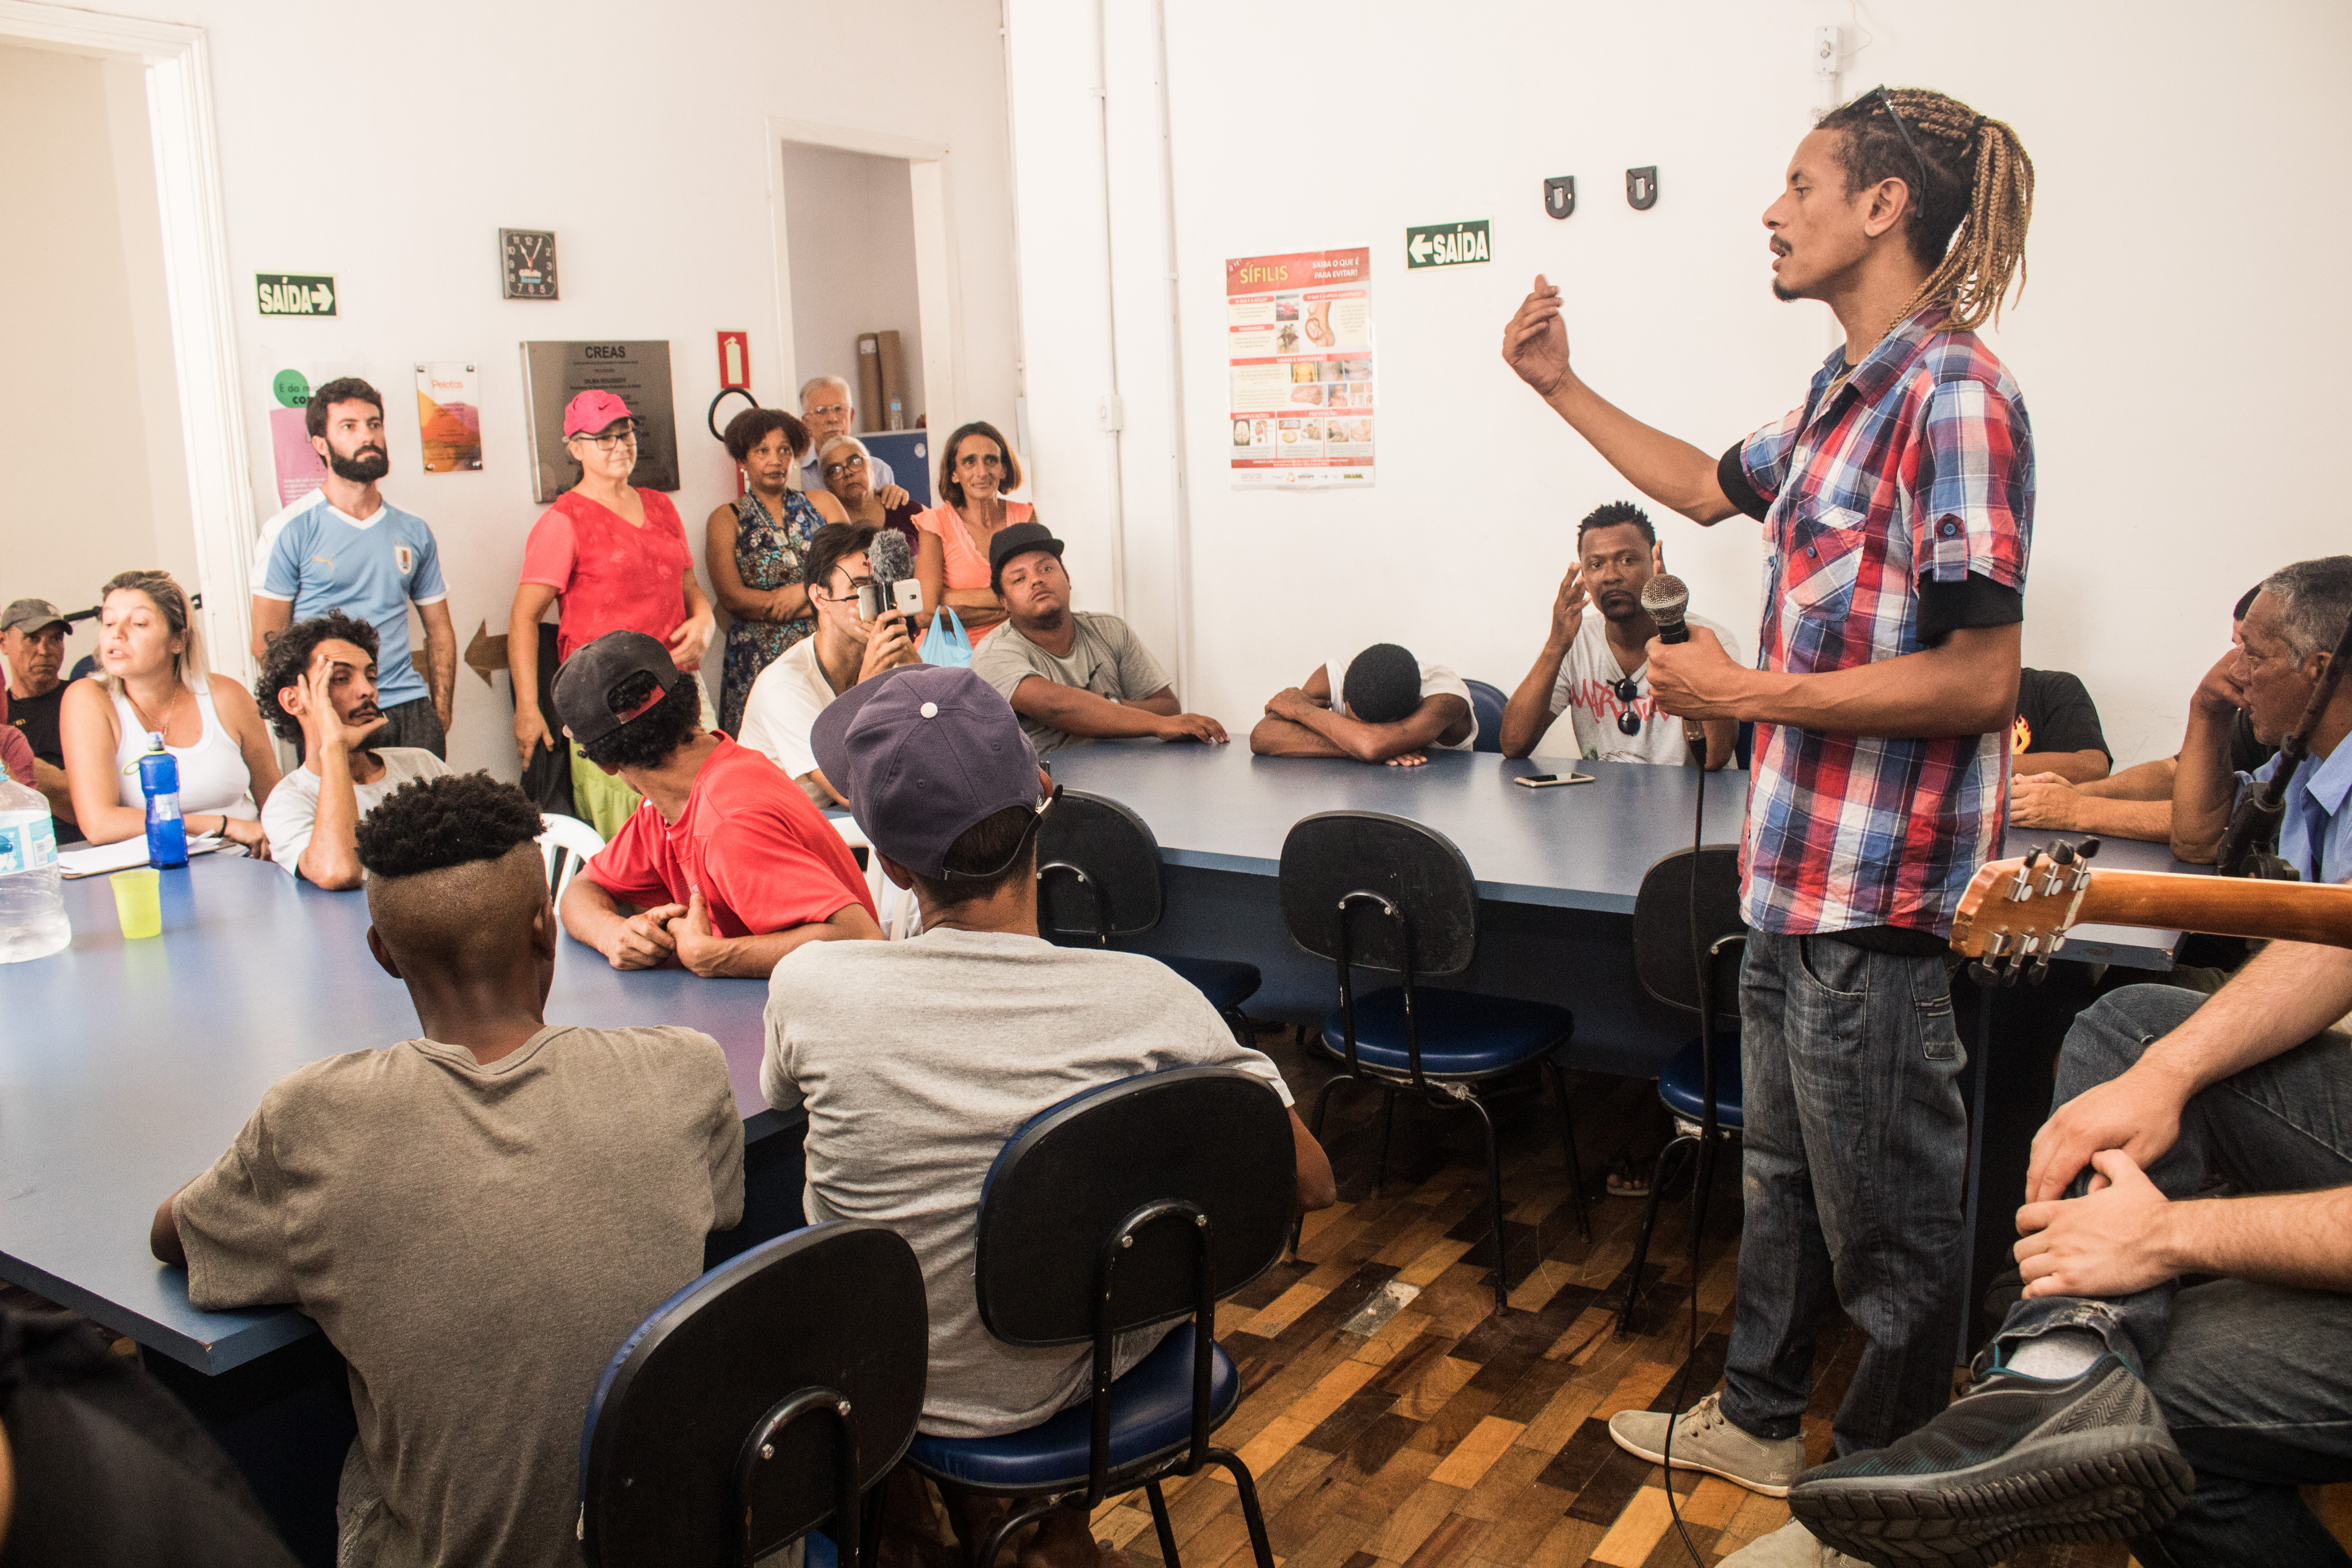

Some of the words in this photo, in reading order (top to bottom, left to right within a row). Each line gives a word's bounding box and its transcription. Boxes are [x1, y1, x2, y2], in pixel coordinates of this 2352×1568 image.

[525, 236, 532, 245] 12
[1433, 225, 1488, 264] SAÍDA
[507, 246, 515, 255] 10
[546, 247, 551, 256] 2
[546, 261, 552, 270] 3
[1312, 260, 1332, 269] SAIBA
[1339, 258, 1354, 267] QUE
[1355, 256, 1359, 265] É
[1240, 263, 1289, 284] SÍFILIS
[1332, 269, 1357, 278] EVITAR!
[259, 277, 314, 313] SAÍDA
[585, 346, 626, 358] CREAS
[431, 379, 463, 388] Pelotas
